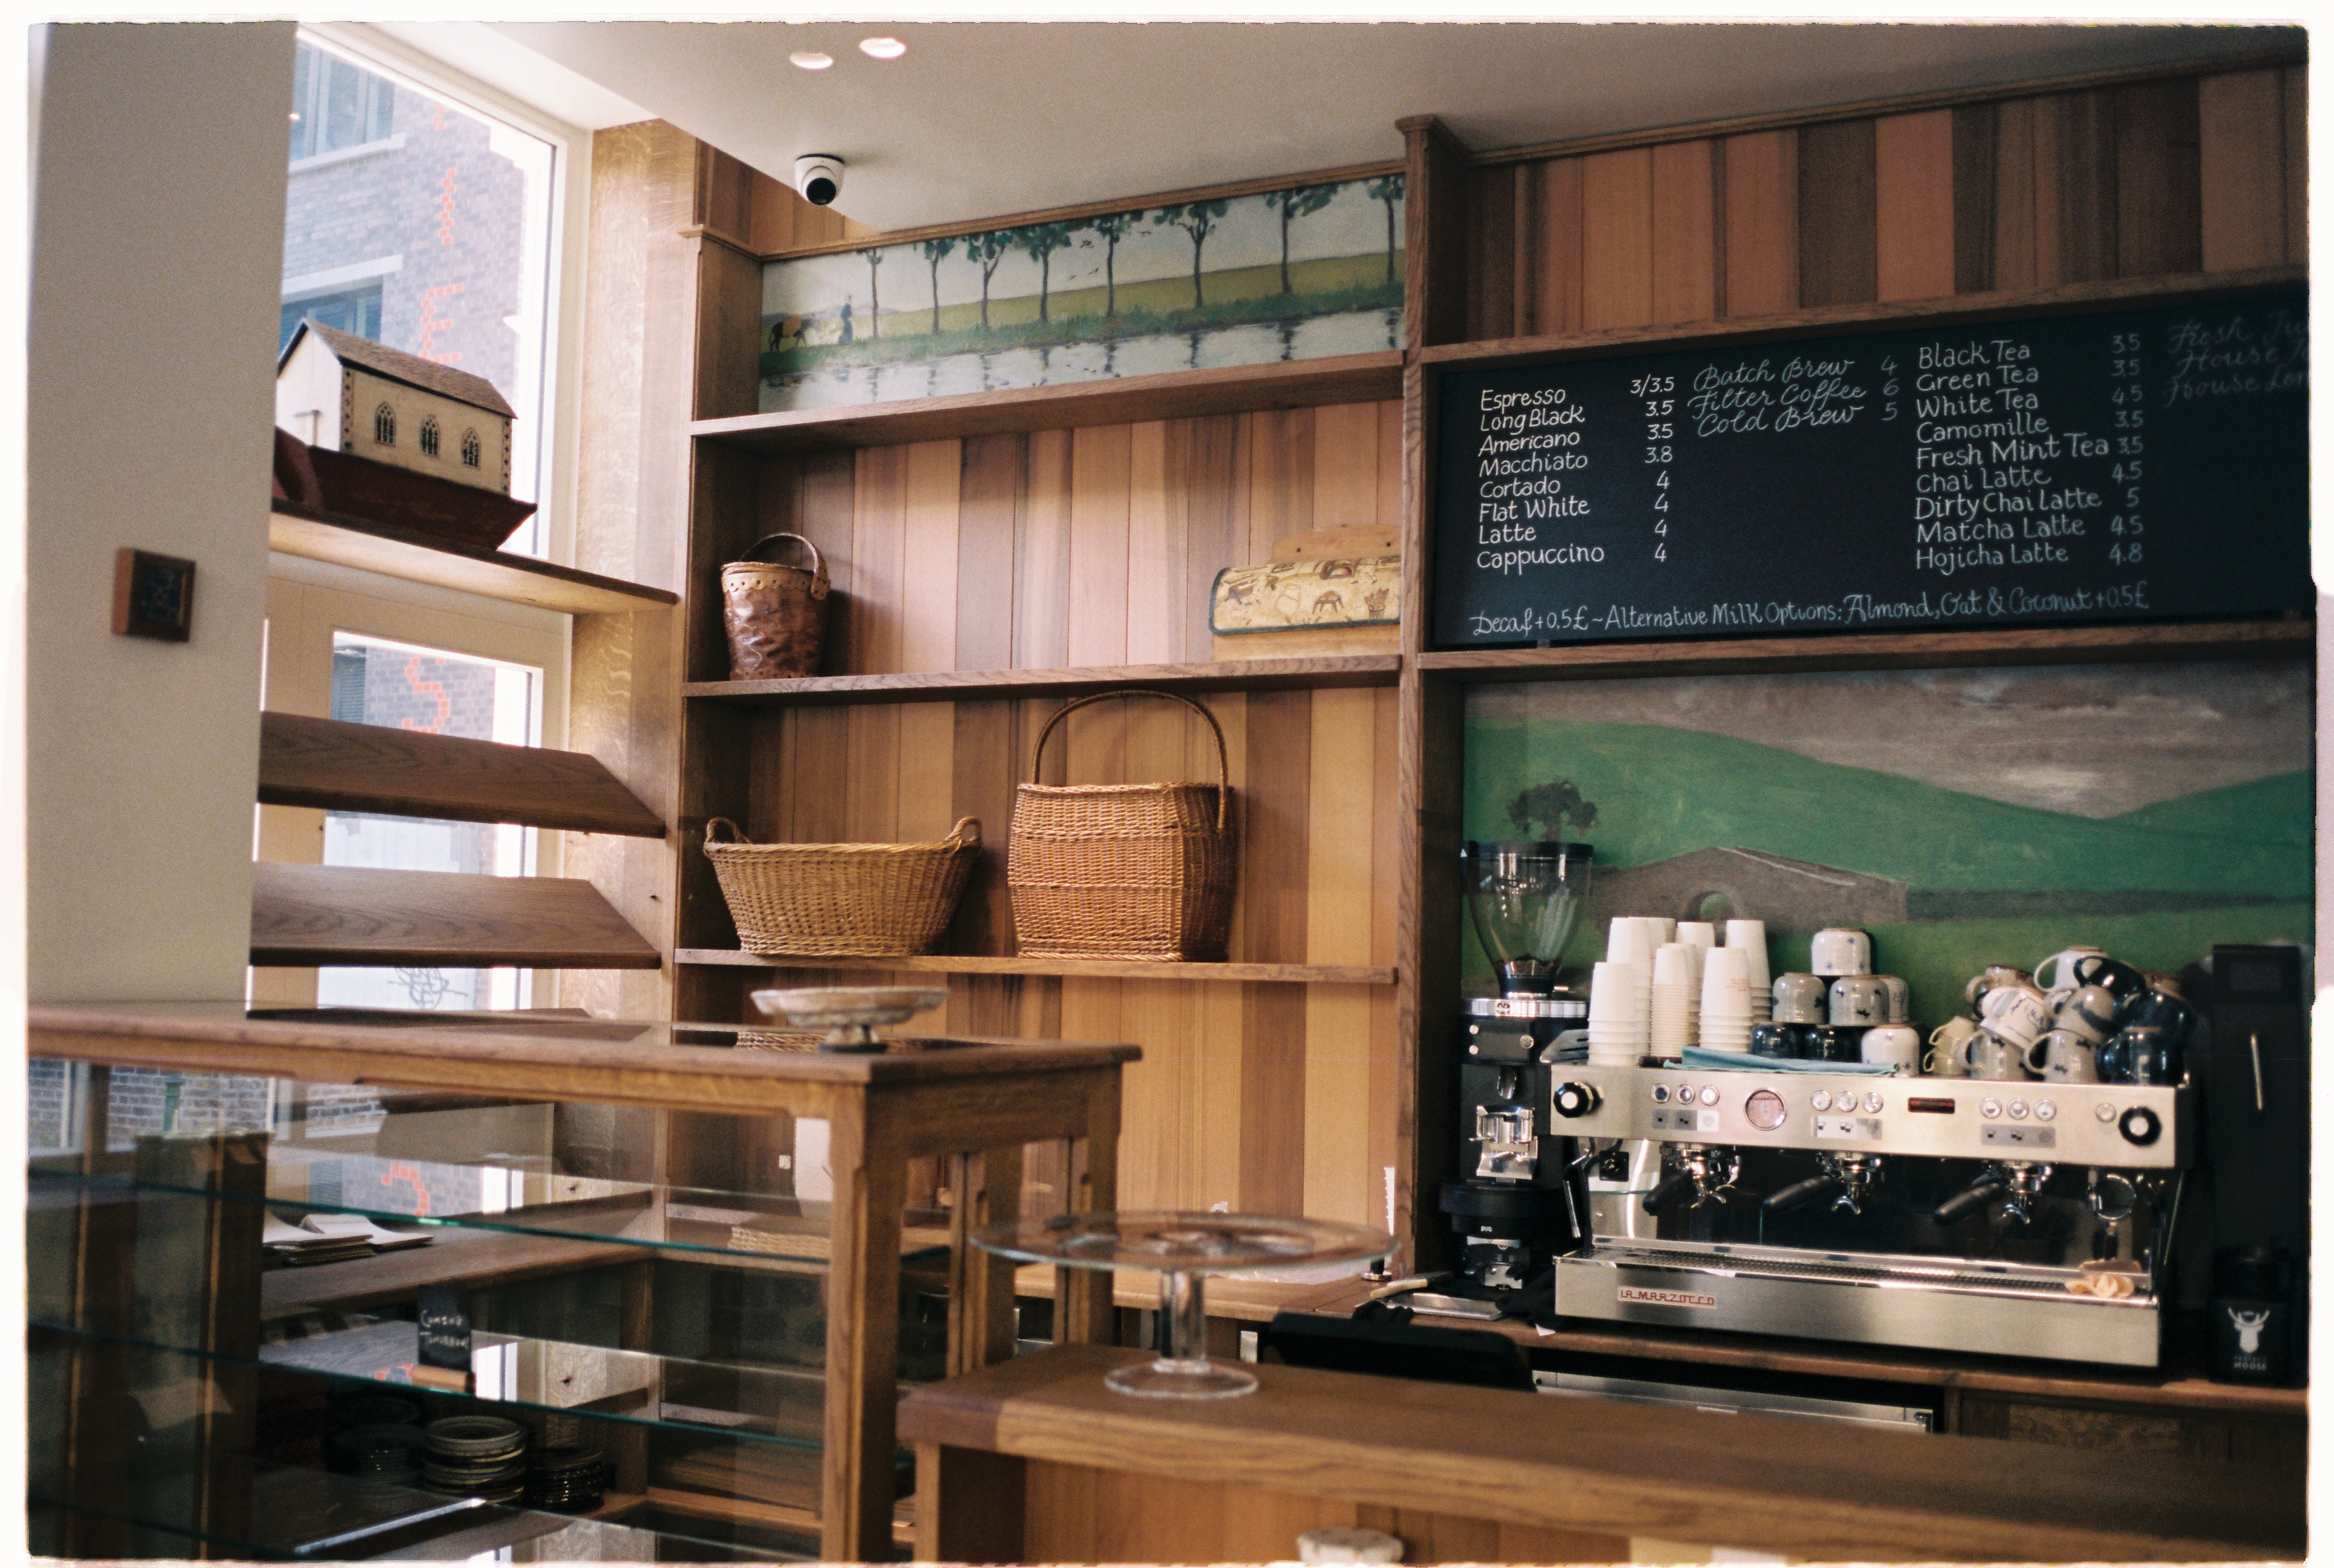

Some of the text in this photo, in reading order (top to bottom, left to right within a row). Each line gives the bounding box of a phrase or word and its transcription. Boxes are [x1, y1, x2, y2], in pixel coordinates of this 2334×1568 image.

[1919, 342, 1990, 369] Black
[1990, 339, 2030, 362] Tea
[1694, 355, 1898, 391] Batch Brew 4
[1916, 359, 2141, 391] Green Tea 3.5
[1480, 374, 1674, 414] Espresso 3/3.5
[1687, 377, 1898, 420] Filter Coffee 6
[1916, 393, 1993, 418] White
[1995, 388, 2039, 411] Tea
[1480, 400, 1674, 435] Long Black 3.5
[1698, 402, 1898, 437] Cold Brew 5
[1916, 410, 2144, 443] Camomille 3.5
[1478, 423, 1673, 457] Americano 3.5
[1916, 432, 2144, 469] Fresh Mint Tea 3.5
[1479, 446, 1673, 477] Macchiato 3.8
[1916, 461, 2143, 493] Chai Latte 4.5
[1480, 471, 1670, 499] Cortado 4
[1479, 493, 1669, 523] Flat White 4
[1914, 487, 2140, 522] Dirty Chai Latte 5
[1479, 519, 1667, 544] Latte 4
[1917, 514, 2143, 543] Matcha Latte 4.5
[1477, 543, 1667, 575] Cappuccino 4
[1916, 542, 2143, 576] Hojicha Latte 4.8
[1604, 604, 1708, 631] Alternative
[1941, 589, 1982, 616] Oat
[1987, 586, 2007, 616] &
[2009, 586, 2094, 614] Coconut
